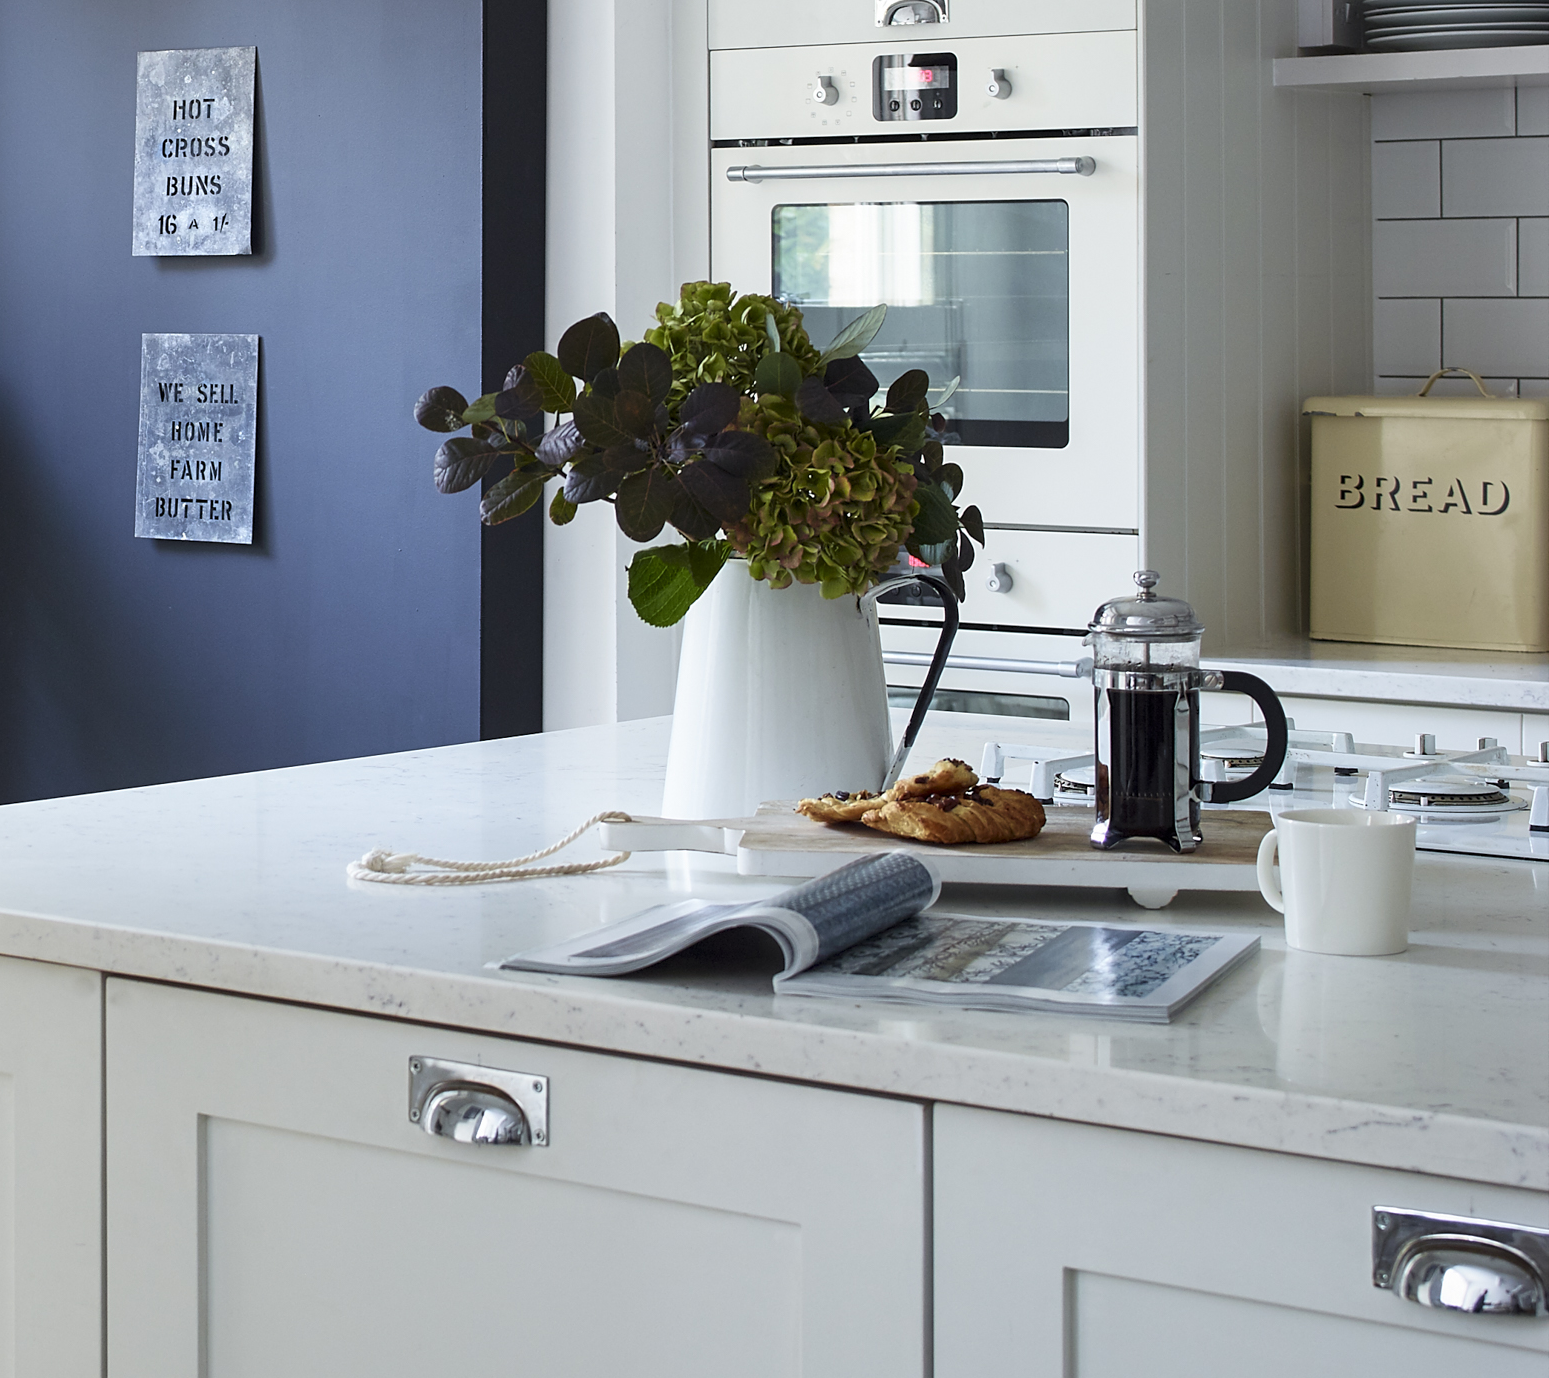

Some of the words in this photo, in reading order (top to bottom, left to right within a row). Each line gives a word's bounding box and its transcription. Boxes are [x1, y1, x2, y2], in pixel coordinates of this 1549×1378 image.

[173, 98, 215, 120] HOT
[161, 136, 230, 158] CROSS
[166, 174, 222, 196] BUNS
[158, 214, 177, 235] 16
[188, 218, 199, 230] A
[158, 382, 184, 403] WE
[197, 383, 239, 404] SELL
[171, 421, 223, 442] HOME
[170, 459, 222, 481] FARM
[1334, 474, 1510, 515] BREAD
[155, 496, 232, 521] BUTTER
